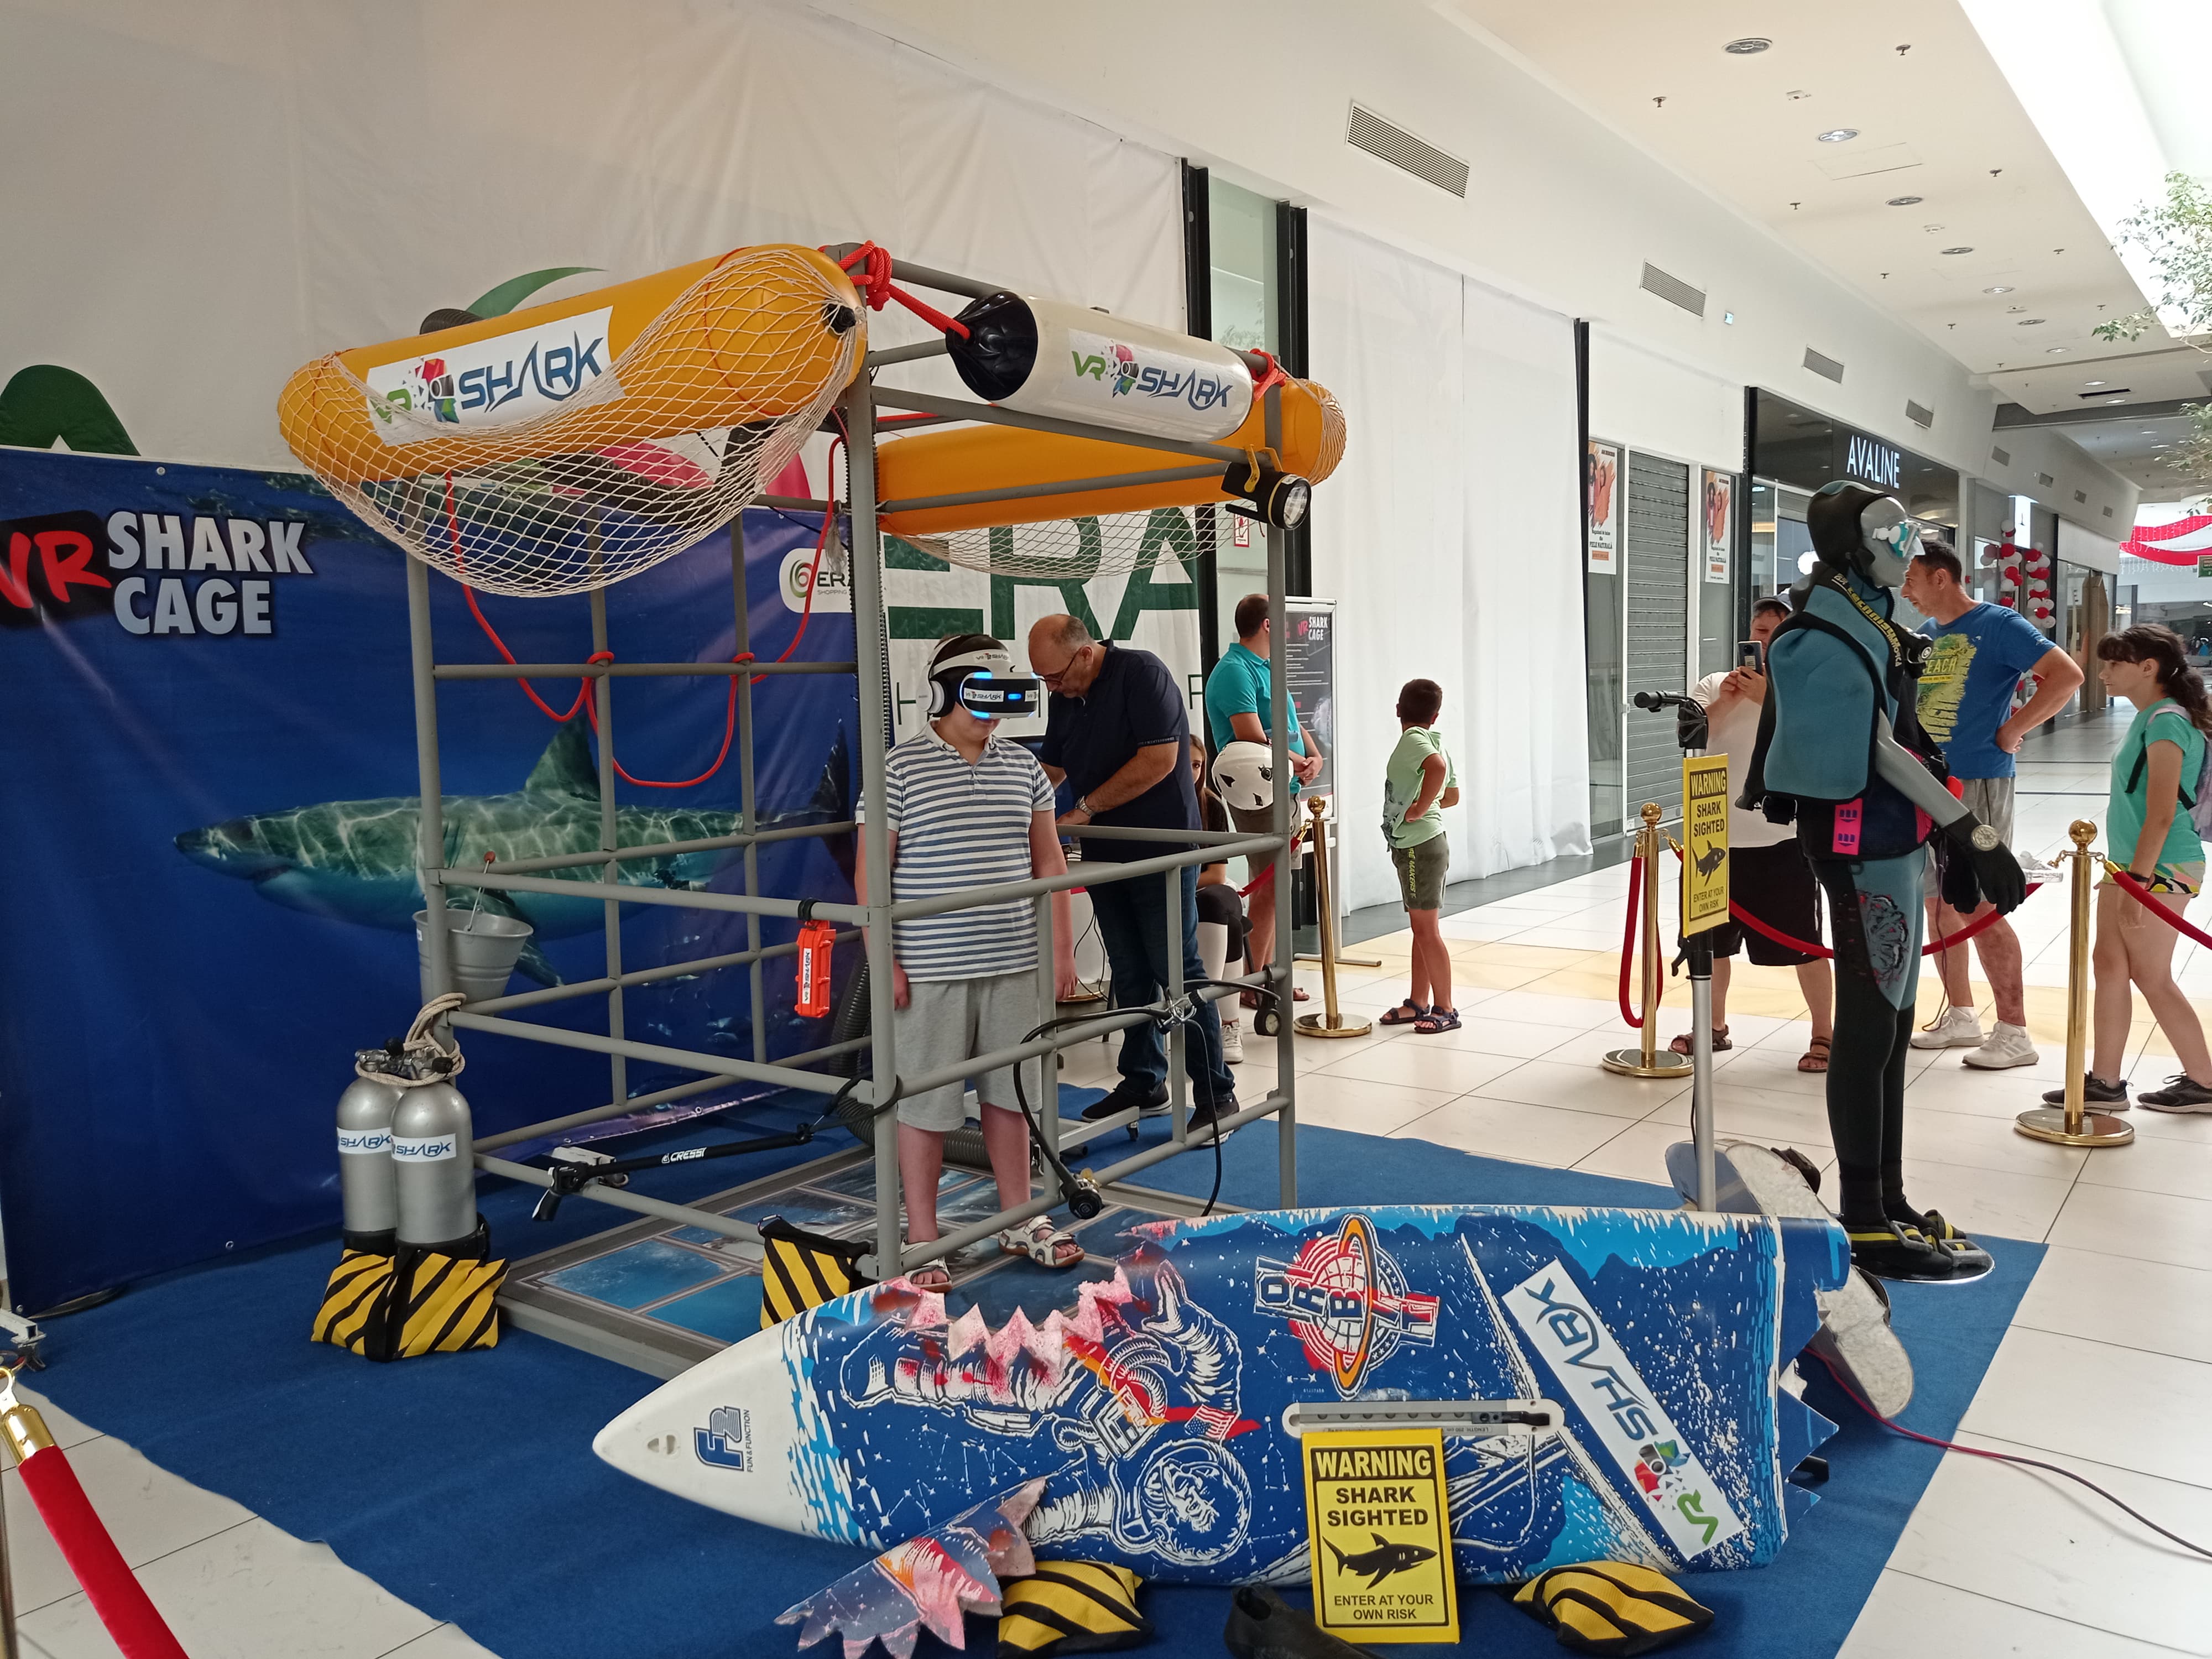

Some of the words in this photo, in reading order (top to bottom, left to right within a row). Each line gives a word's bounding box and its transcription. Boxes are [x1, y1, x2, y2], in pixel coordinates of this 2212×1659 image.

[458, 330, 604, 413] SHARK
[1072, 351, 1107, 381] VR
[1136, 368, 1234, 411] SHARK
[1846, 435, 1900, 489] AVALINE
[108, 510, 314, 575] SHARK
[817, 571, 851, 587] ER
[114, 577, 273, 634] CAGE
[1297, 620, 1309, 636] VR
[1308, 616, 1328, 628] SHARK
[1308, 629, 1323, 640] CAGE
[1691, 770, 1726, 797] WARNING
[1697, 800, 1721, 818] SHARK
[1693, 818, 1725, 837] SIGHTED
[1693, 891, 1708, 903] ENTER
[1708, 889, 1713, 899] AT
[1713, 885, 1724, 896] YOUR
[1699, 901, 1709, 912] OWN
[1709, 899, 1719, 909] RISK
[340, 1134, 391, 1149] SHARK
[396, 1141, 452, 1157] SHARK
[670, 1146, 707, 1162] CRESSI
[1524, 1277, 1659, 1441] SHARK
[693, 1405, 744, 1472] F2
[743, 1409, 752, 1449] FUNCTION
[1316, 1449, 1432, 1478] WARNING
[1335, 1486, 1416, 1504] SHARK
[1327, 1508, 1429, 1527] SIGHTED
[1676, 1488, 1719, 1545] VR
[1334, 1595, 1375, 1606] ENTER
[1378, 1595, 1394, 1606] AT
[1396, 1594, 1434, 1605] YOUR
[1353, 1609, 1383, 1620] OWN
[1386, 1608, 1417, 1619] RISK
